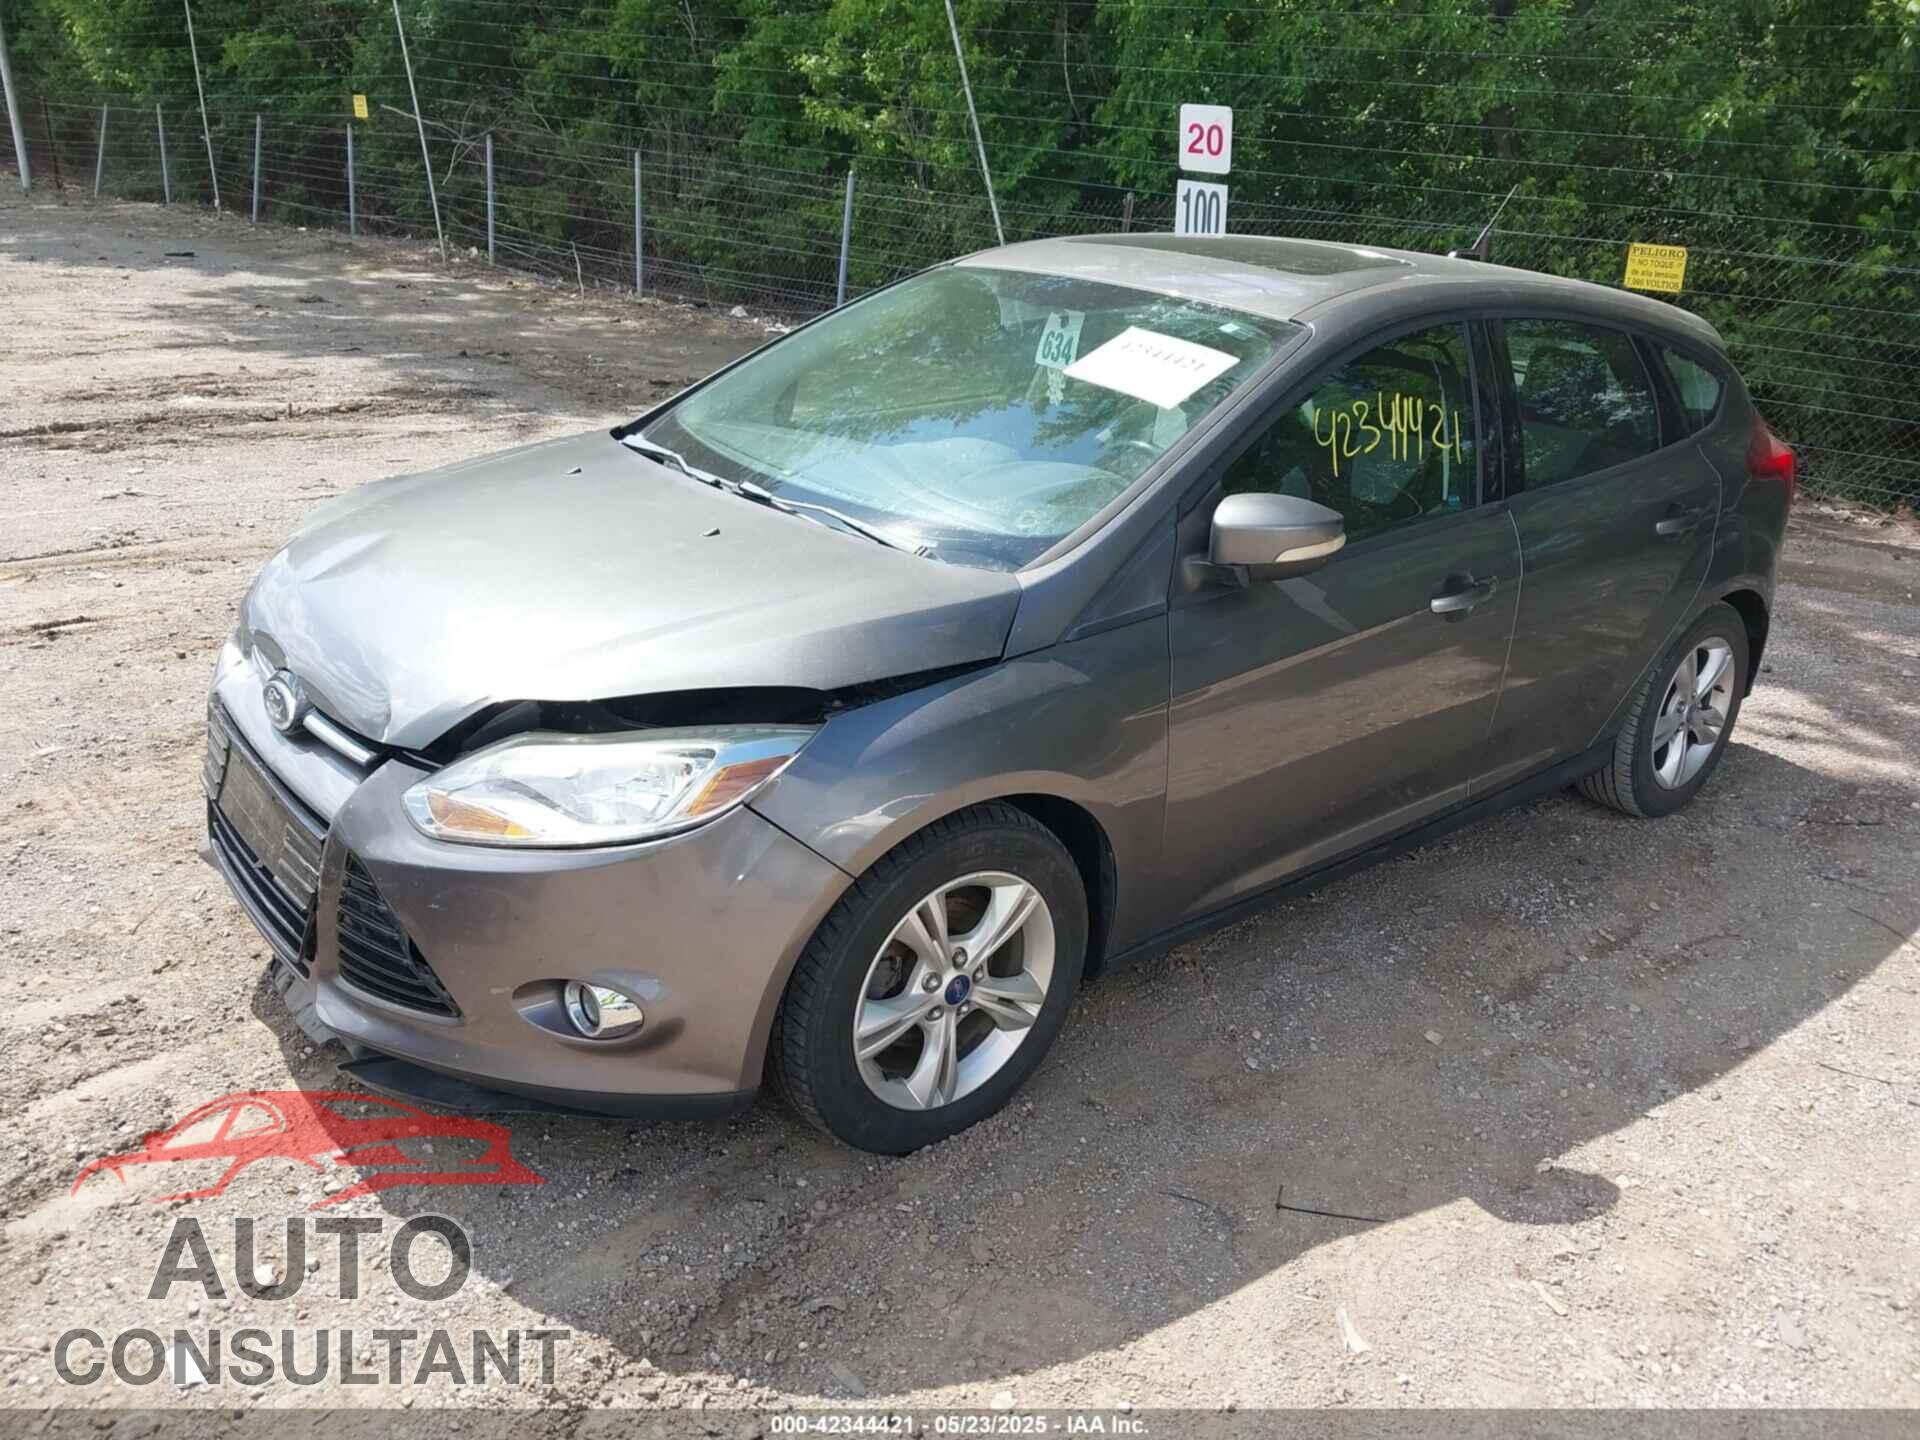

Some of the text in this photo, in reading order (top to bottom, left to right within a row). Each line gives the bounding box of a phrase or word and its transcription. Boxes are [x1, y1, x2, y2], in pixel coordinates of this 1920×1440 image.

[1187, 123, 1224, 156] 20
[1182, 187, 1221, 234] 100
[1631, 246, 1686, 259] PELIGRO
[1041, 330, 1074, 365] 634
